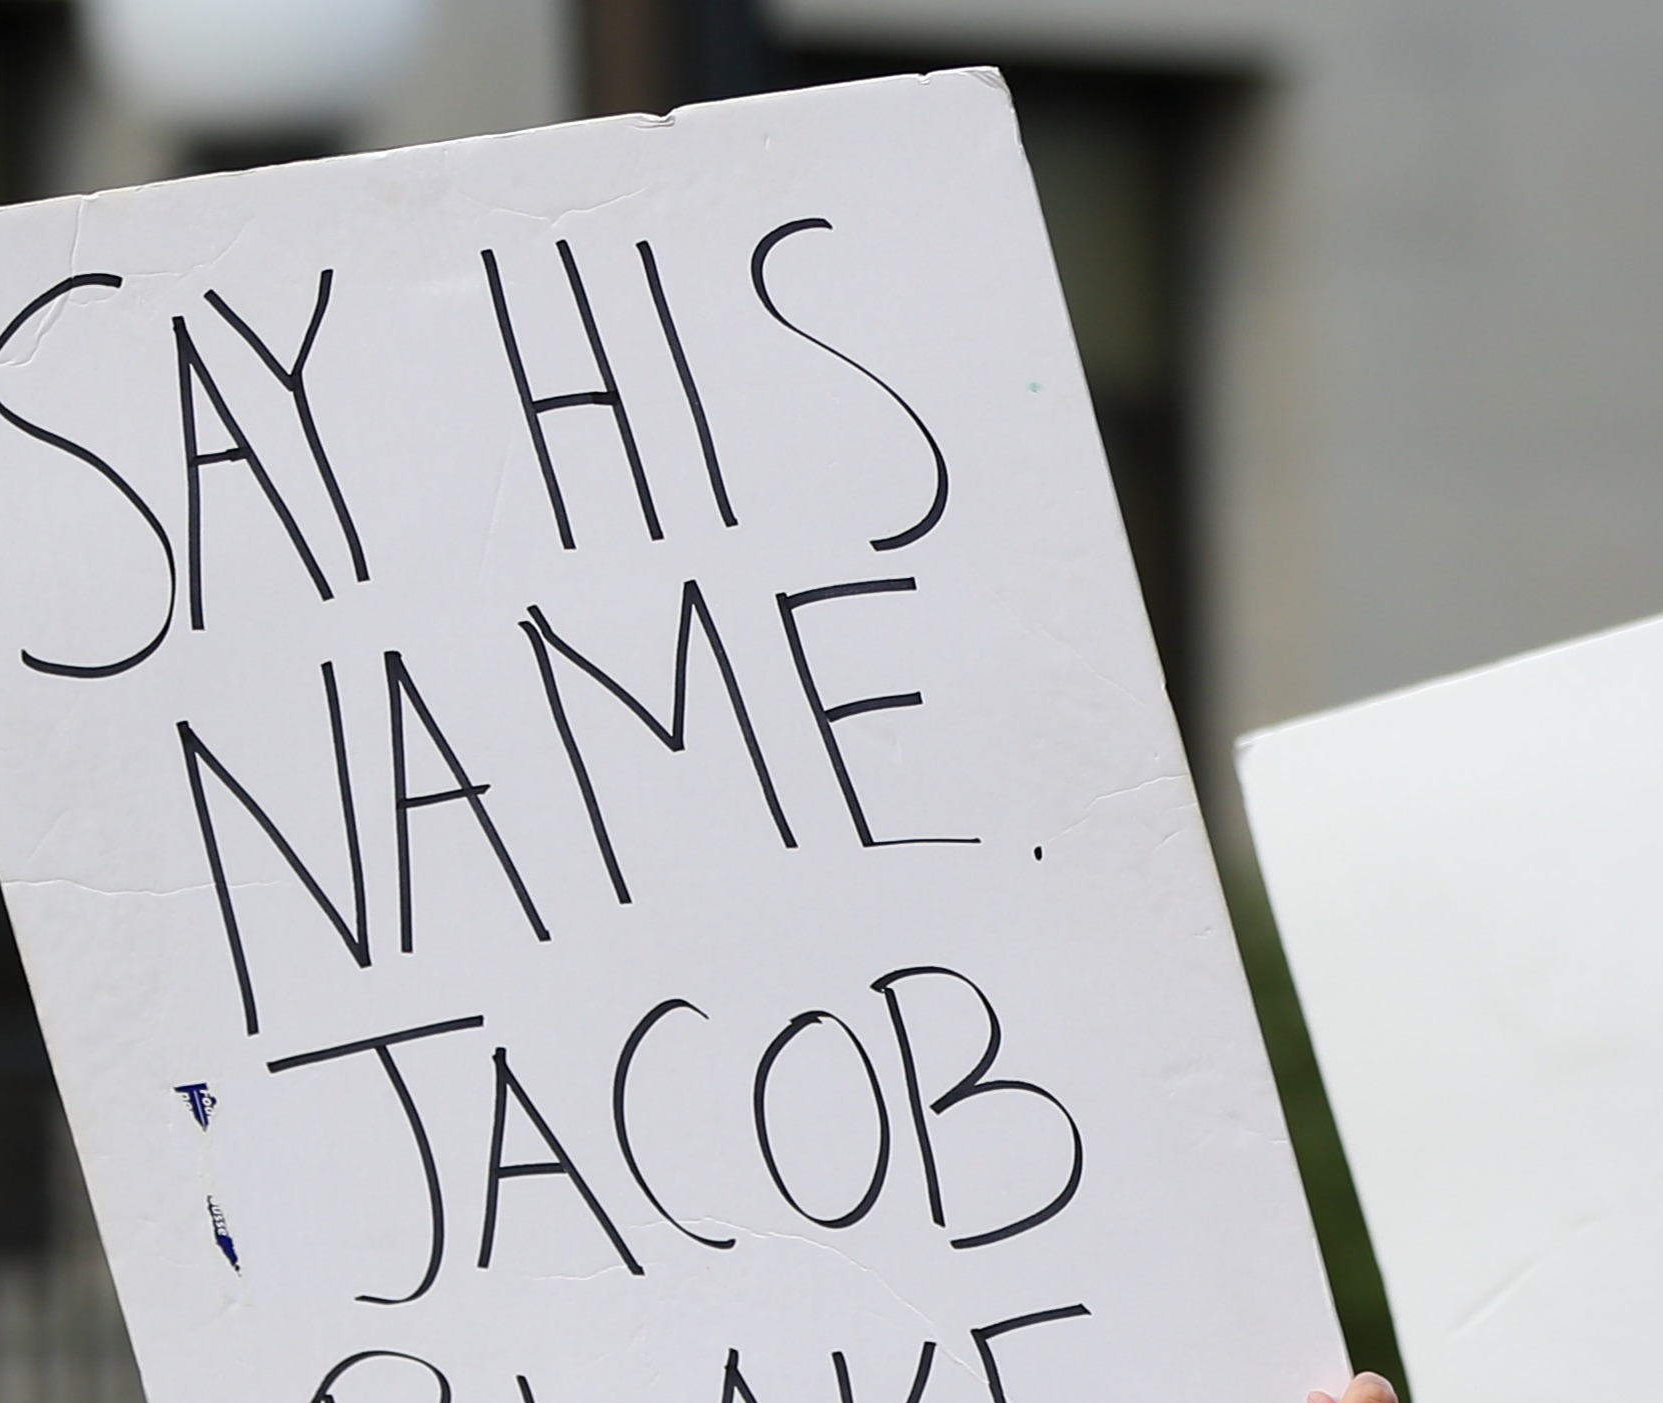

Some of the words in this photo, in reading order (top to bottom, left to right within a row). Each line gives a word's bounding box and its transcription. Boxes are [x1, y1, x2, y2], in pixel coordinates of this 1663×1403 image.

[481, 218, 948, 551] HIS
[177, 577, 1044, 1035] NAME.
[267, 966, 1082, 1304] JACOB
